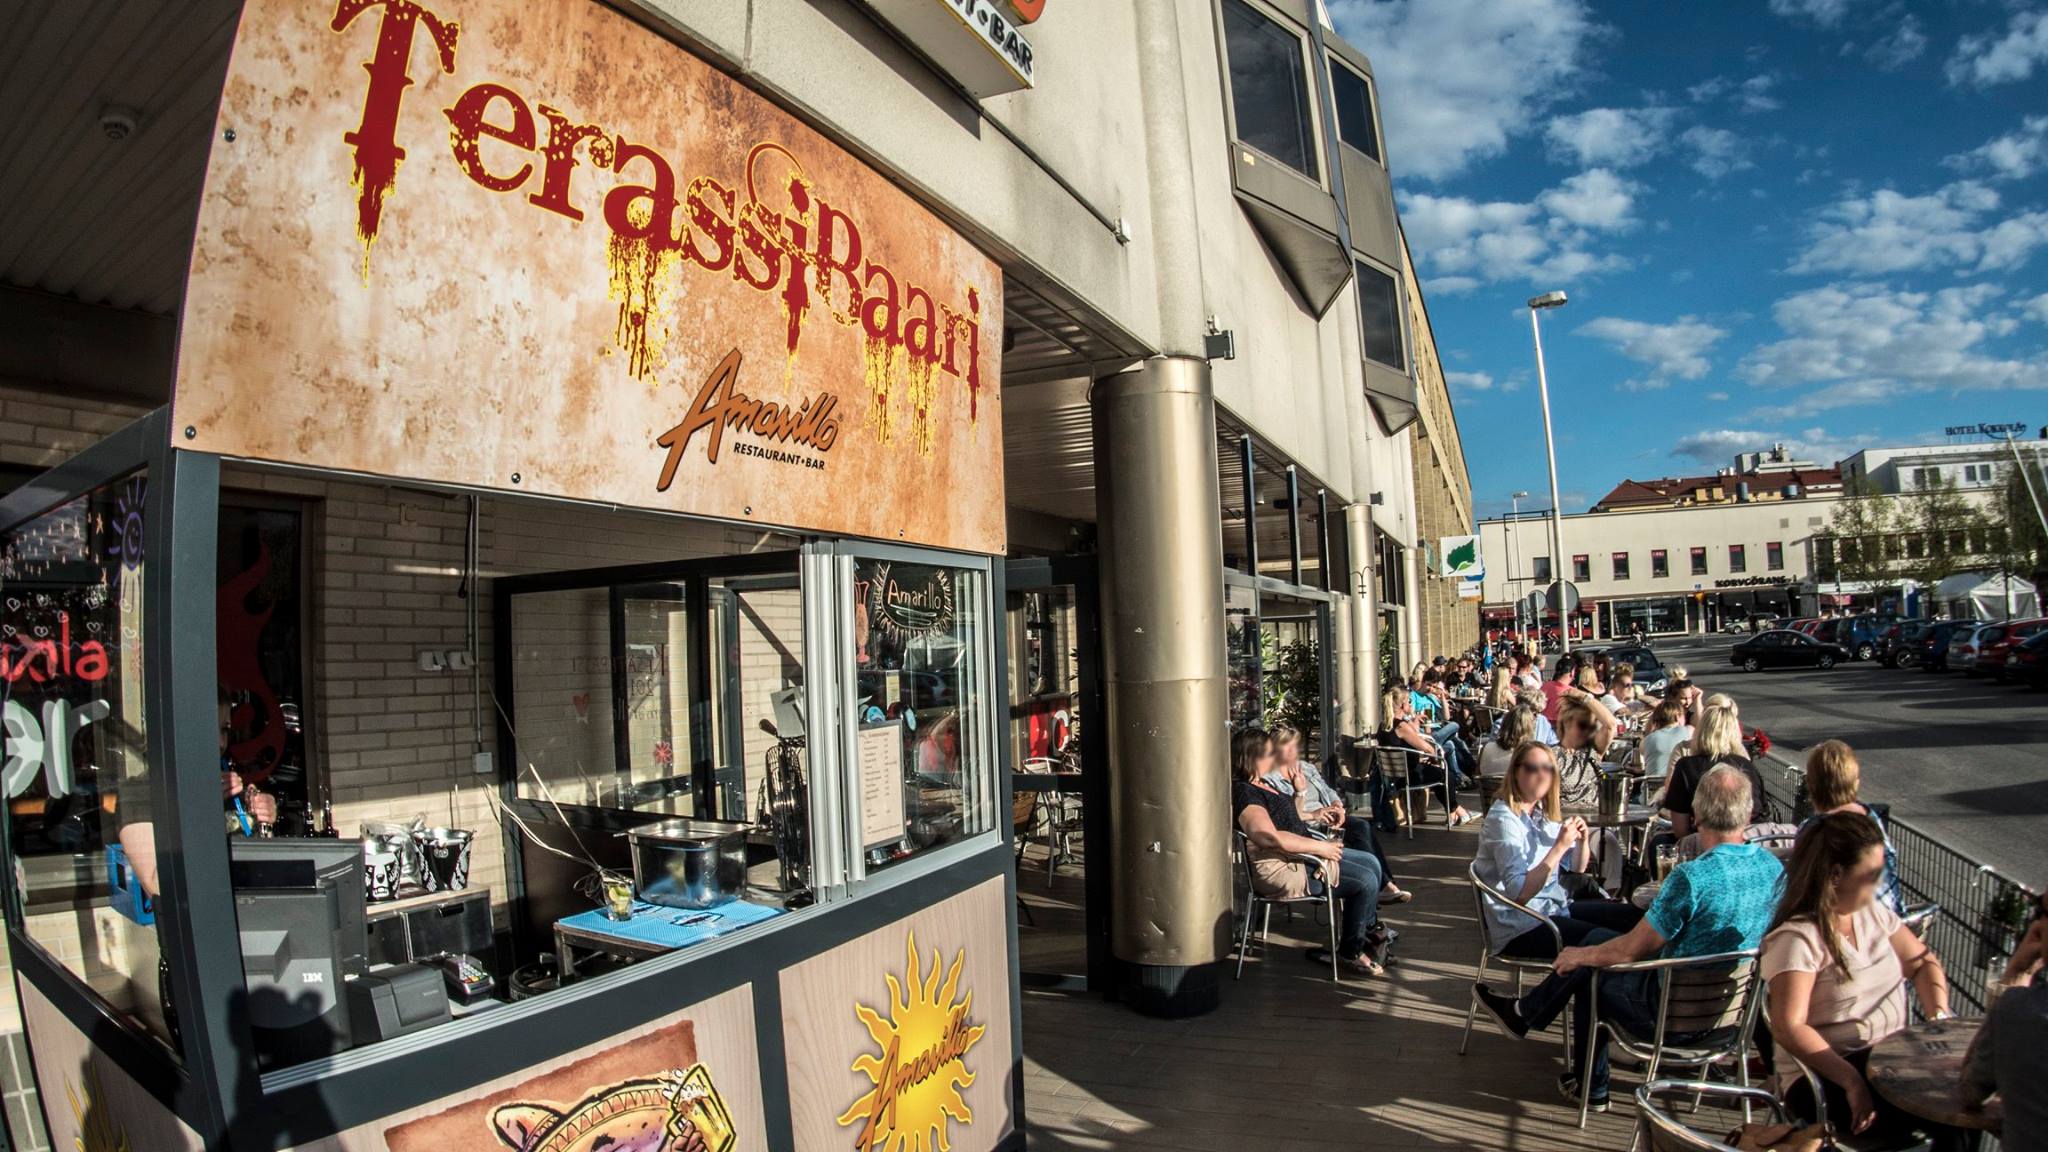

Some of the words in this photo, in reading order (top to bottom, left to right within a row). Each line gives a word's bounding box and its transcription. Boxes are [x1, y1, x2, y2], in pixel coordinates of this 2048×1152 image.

[656, 347, 840, 492] Amarillo
[1945, 426, 1977, 436] HOTEL
[887, 579, 942, 610] Amarillo
[302, 972, 323, 983] IBM
[855, 1005, 970, 1152] Amarillo
